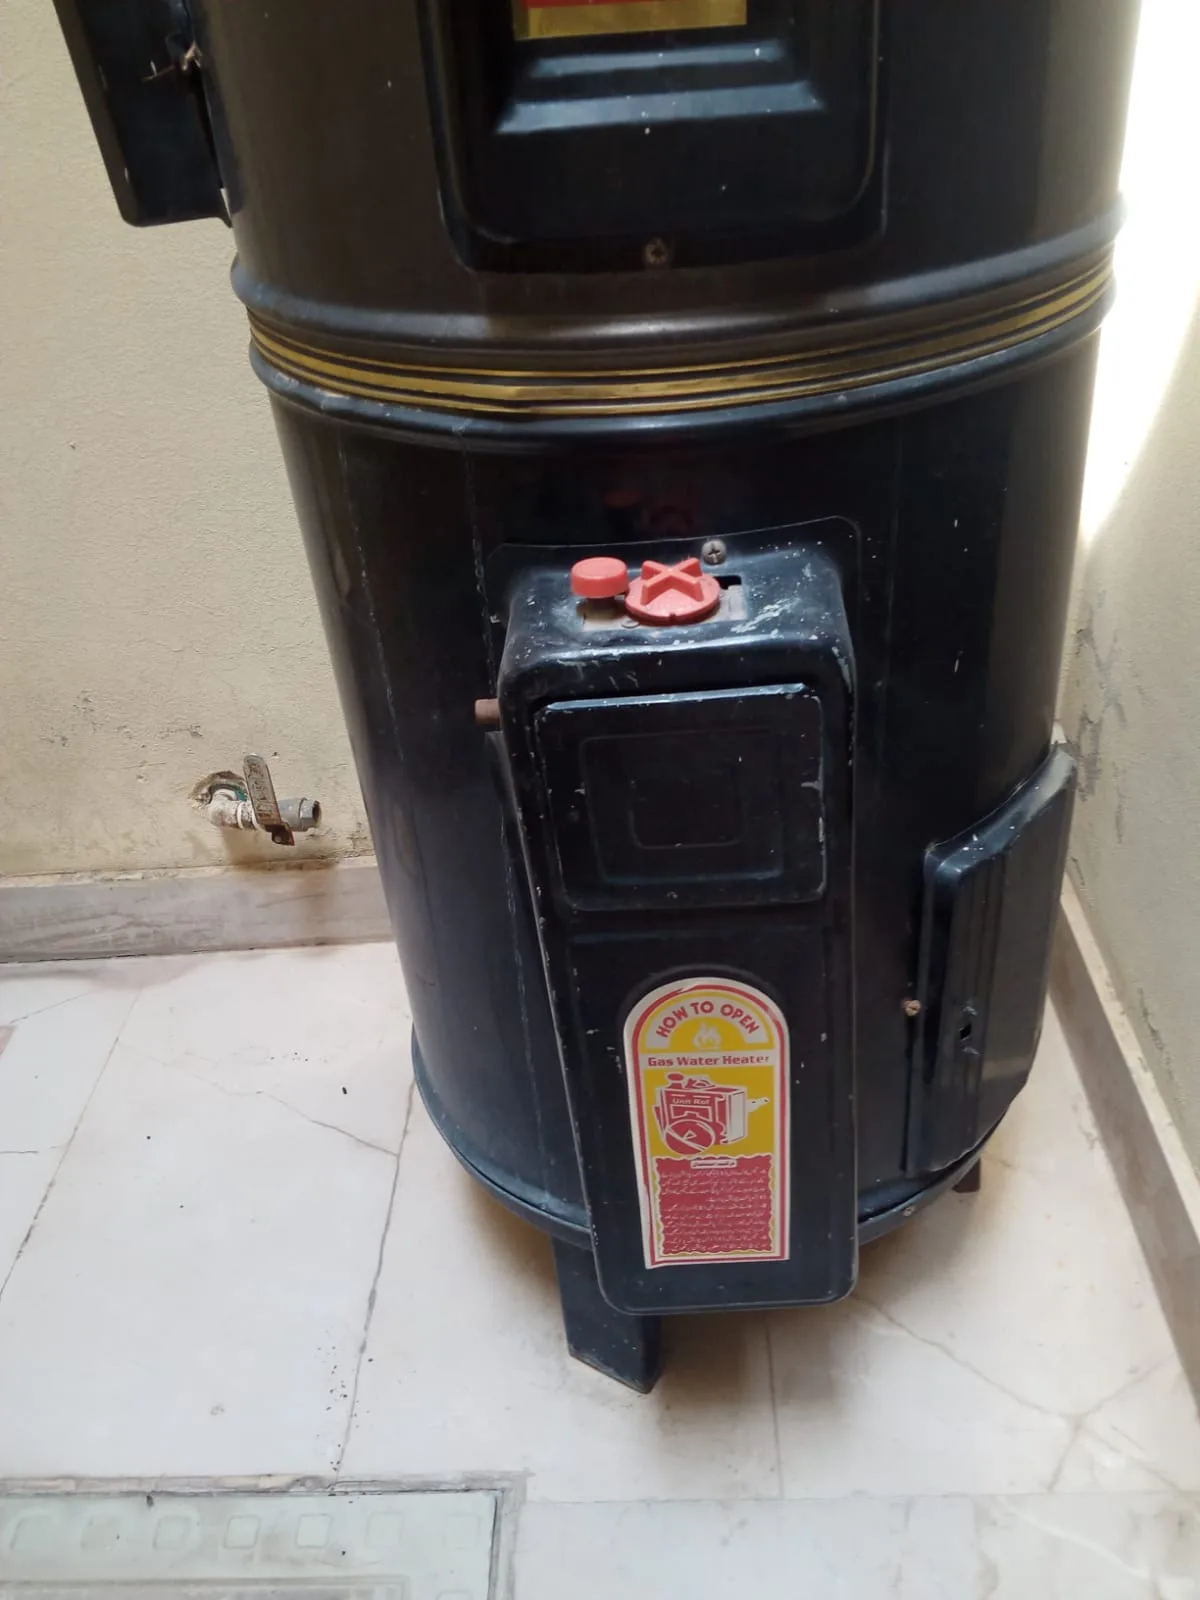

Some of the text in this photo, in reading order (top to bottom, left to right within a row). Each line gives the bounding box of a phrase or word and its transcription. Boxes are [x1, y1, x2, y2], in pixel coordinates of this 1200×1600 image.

[656, 1000, 760, 1037] HOW TO OPEN
[648, 1055, 770, 1067] Gas Water Heater
